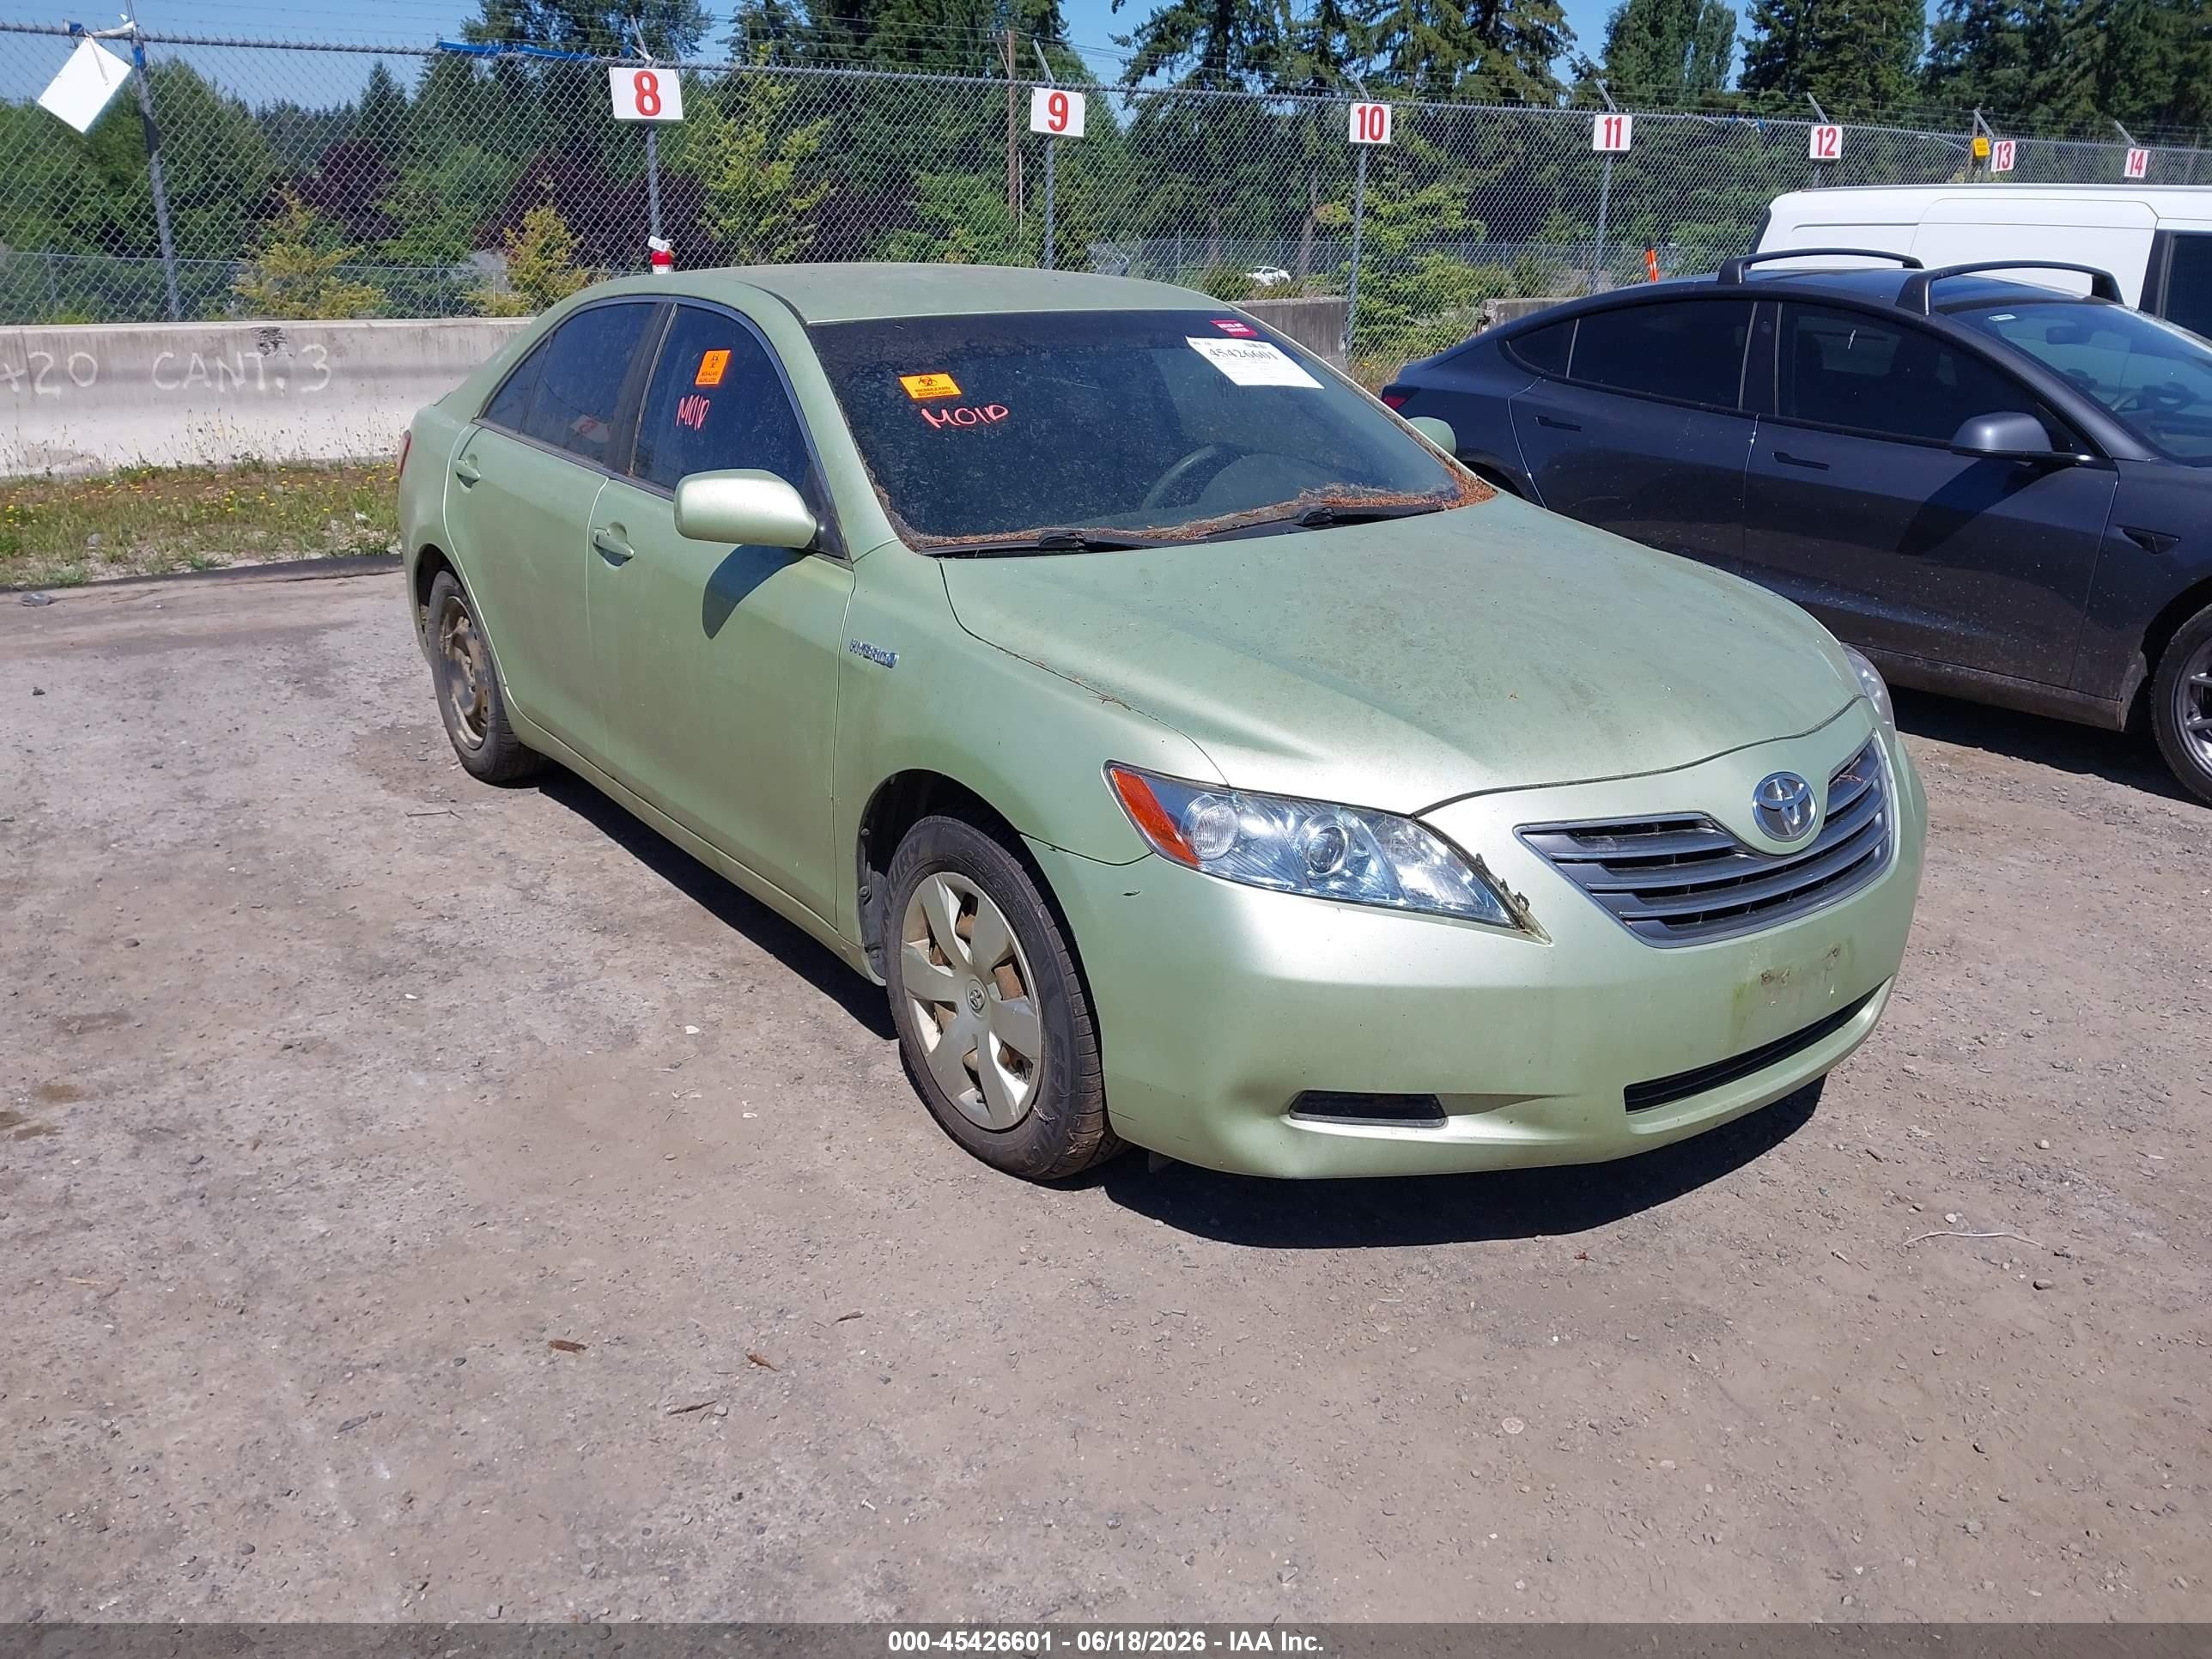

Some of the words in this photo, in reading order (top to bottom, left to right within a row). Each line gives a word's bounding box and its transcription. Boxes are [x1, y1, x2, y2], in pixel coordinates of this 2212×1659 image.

[634, 70, 661, 116] 8
[1048, 92, 1068, 131] 9
[1358, 106, 1384, 141] 10
[1604, 117, 1622, 149] 11
[1817, 127, 1837, 156] 12
[1996, 143, 2012, 169] 13
[2130, 151, 2144, 176] 14
[301, 343, 332, 392] 3
